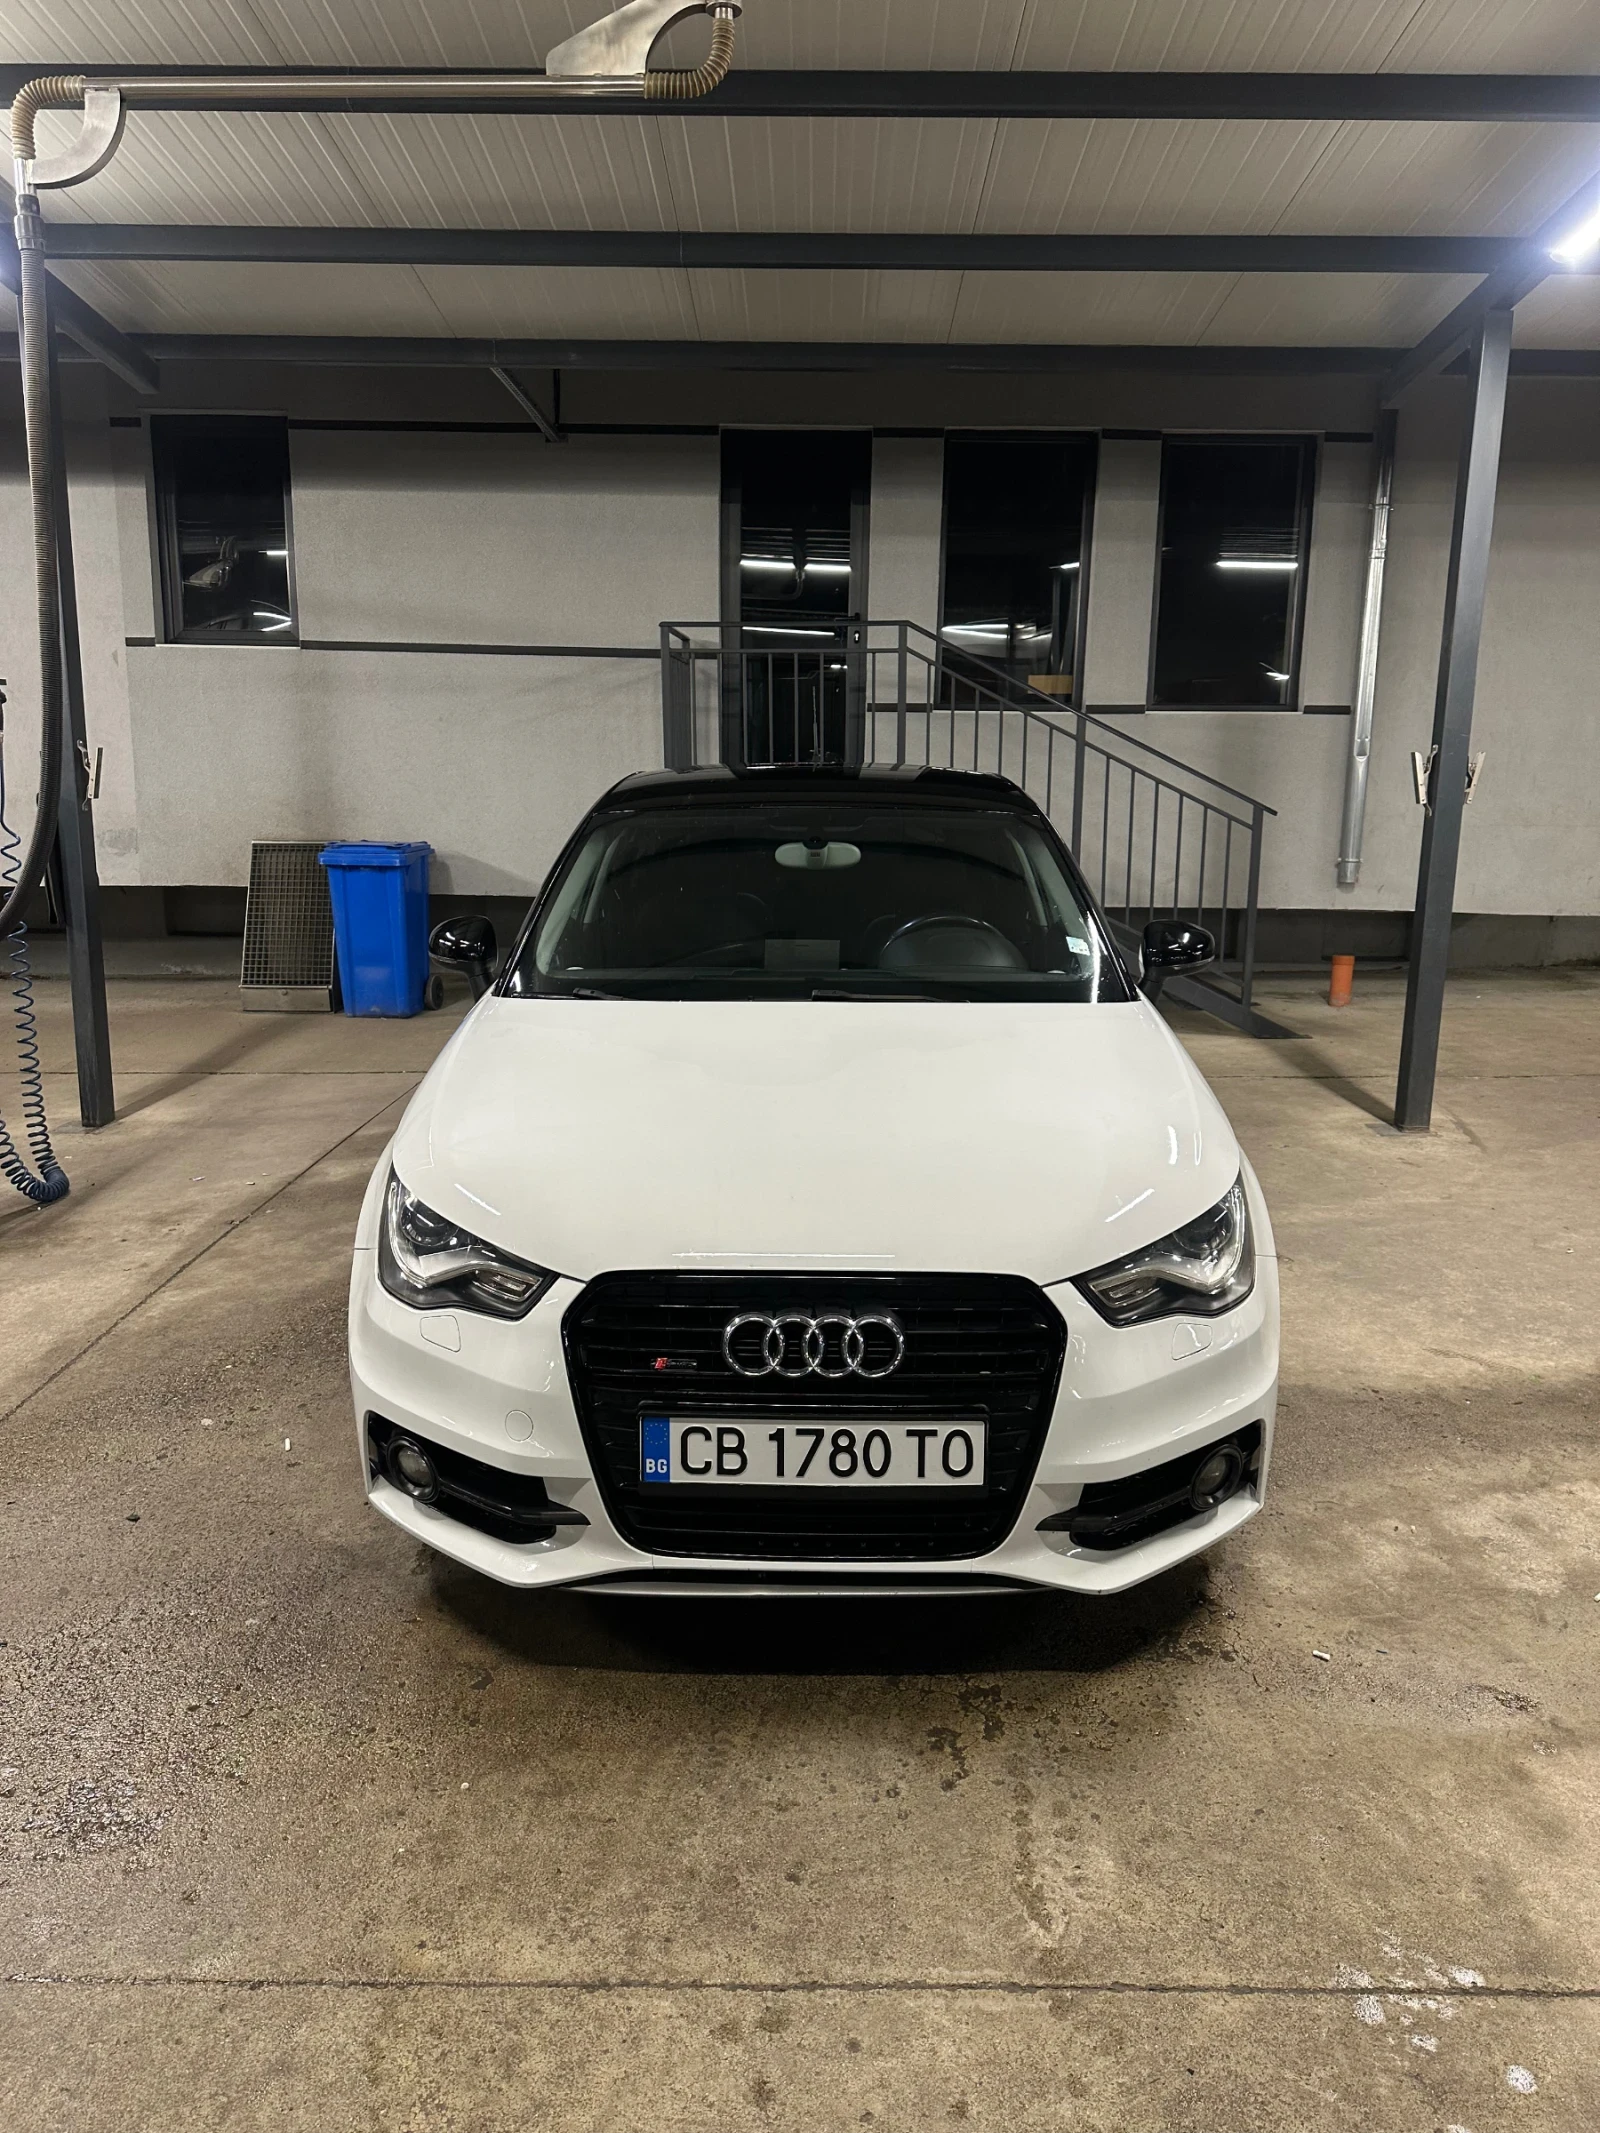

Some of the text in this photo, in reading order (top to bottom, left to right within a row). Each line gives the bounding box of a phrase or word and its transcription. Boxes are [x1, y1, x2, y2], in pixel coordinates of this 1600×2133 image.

[645, 1458, 668, 1474] BG
[680, 1426, 974, 1479] CB 1780 TO
